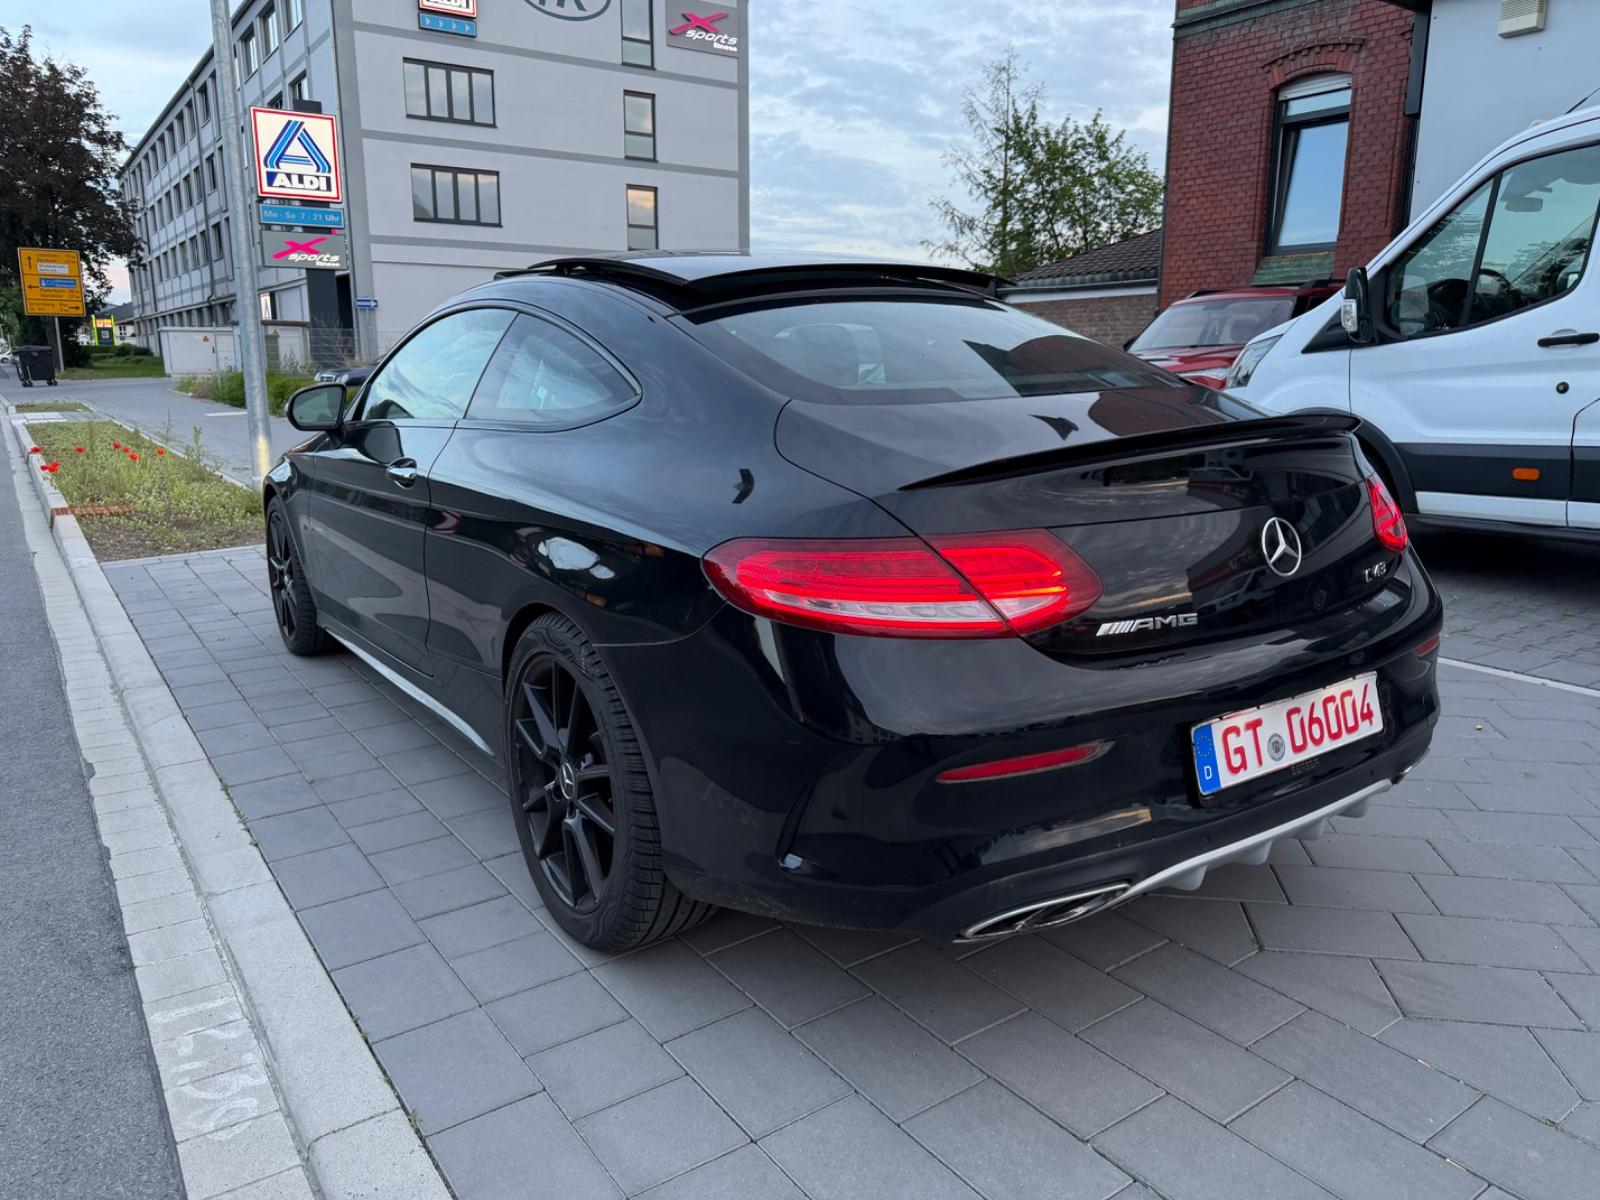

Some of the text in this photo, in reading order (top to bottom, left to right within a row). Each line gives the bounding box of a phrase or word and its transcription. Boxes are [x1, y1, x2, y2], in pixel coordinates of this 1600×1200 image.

[685, 29, 739, 45] sports
[272, 173, 328, 191] ALDI
[312, 213, 323, 221] 21
[325, 213, 340, 222] Uhr
[287, 251, 340, 263] sports
[1130, 612, 1198, 633] AMG
[1221, 683, 1375, 776] GT 06004
[1203, 765, 1213, 780] D
